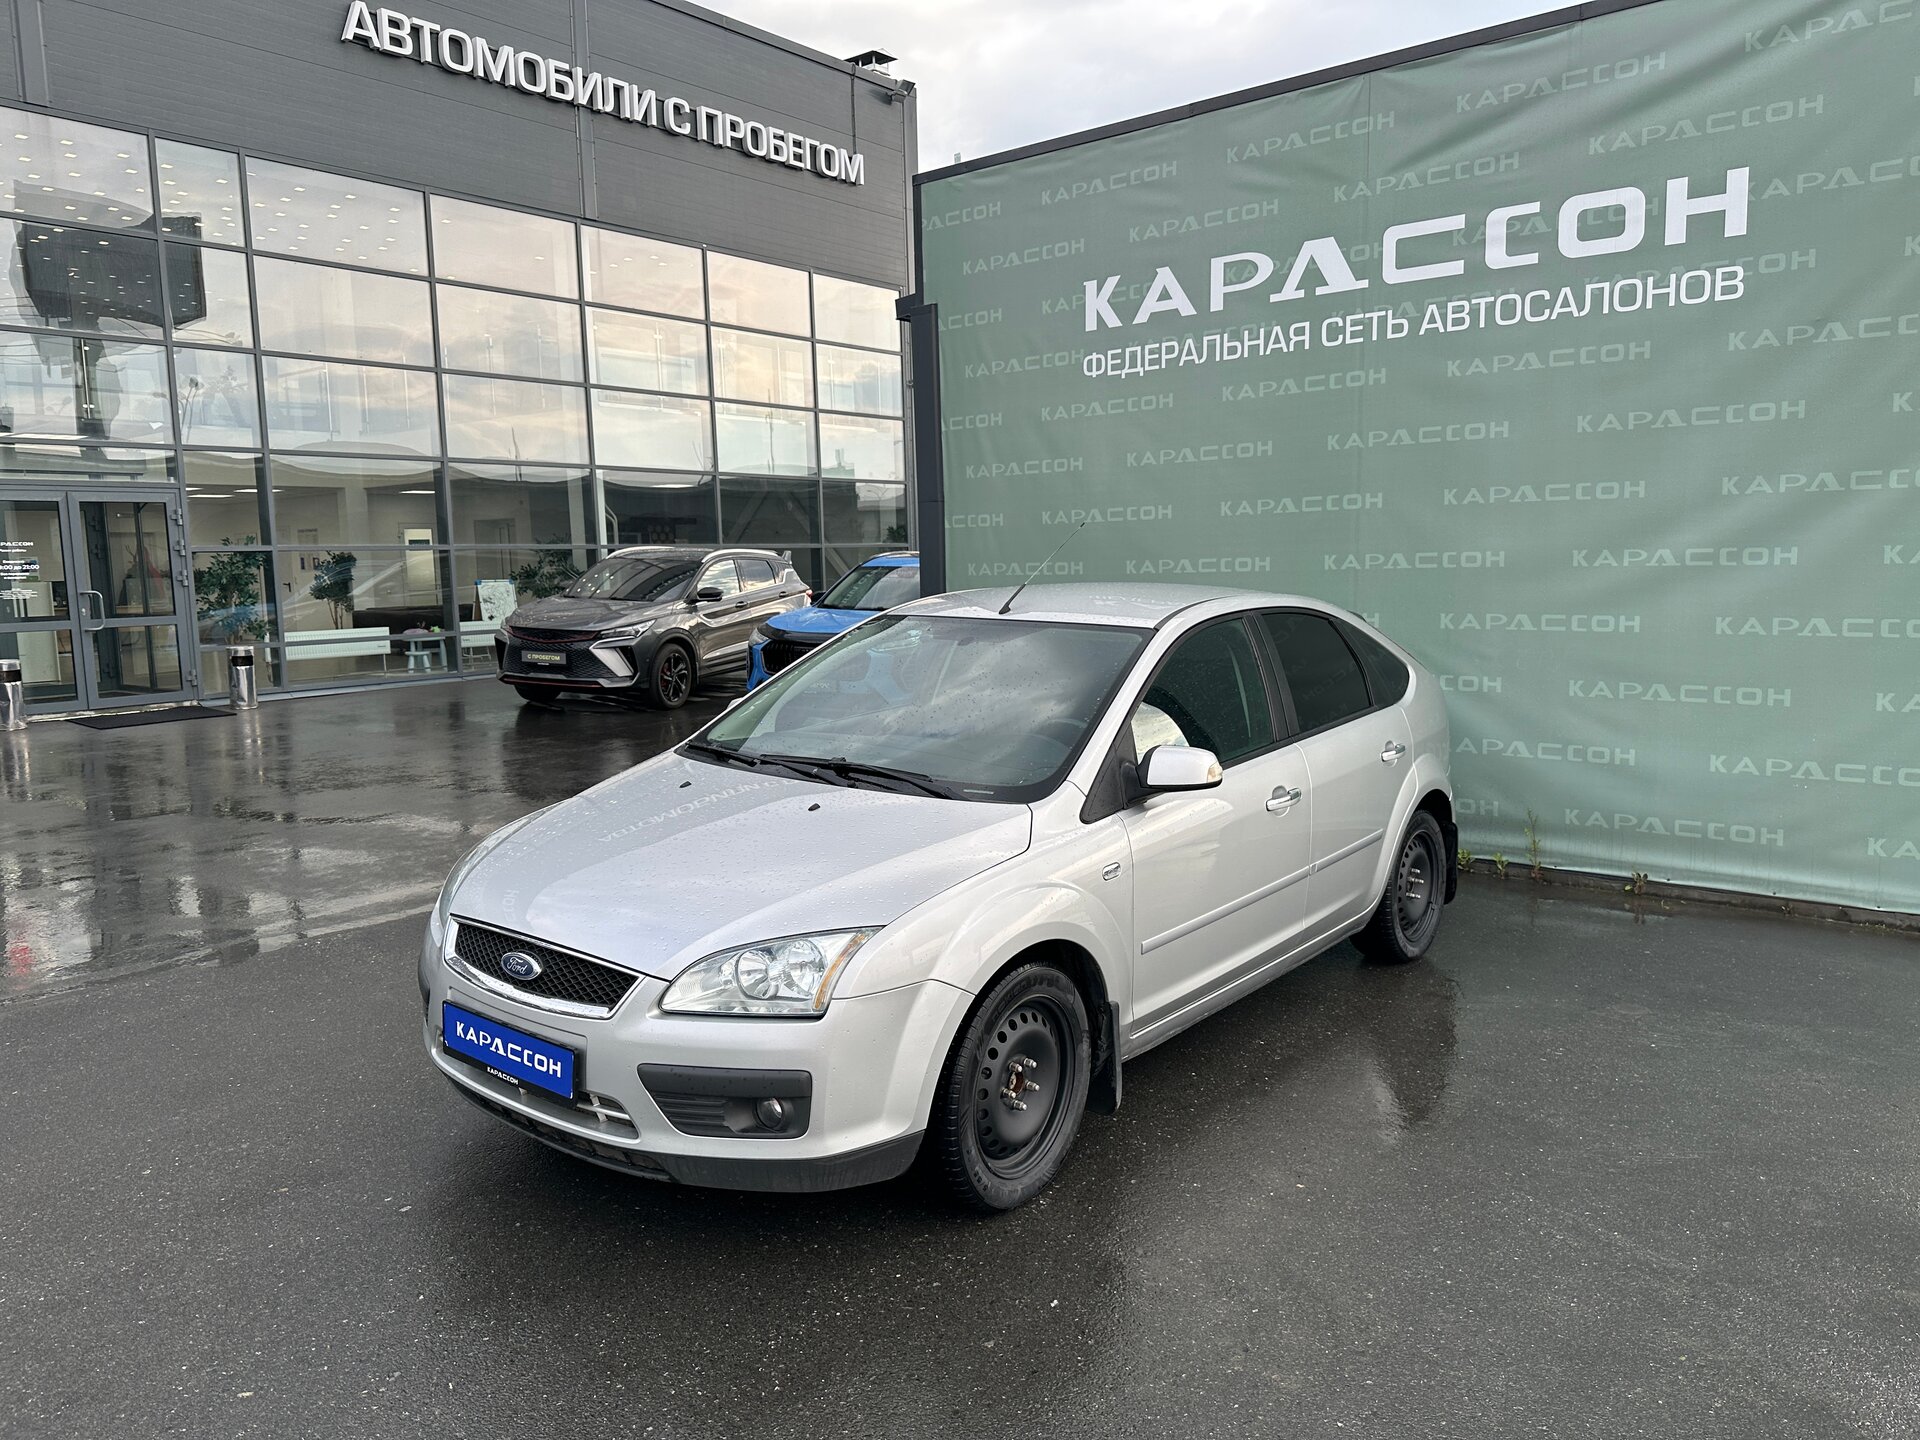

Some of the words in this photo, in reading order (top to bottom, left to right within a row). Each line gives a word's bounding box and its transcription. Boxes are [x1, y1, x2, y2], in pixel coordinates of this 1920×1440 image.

[342, 0, 657, 129] АВТОМОБИЛИ
[664, 97, 692, 136] С
[697, 107, 865, 186] ПРОБЕГОМ
[1456, 51, 1666, 113] КАРАССОН
[1227, 110, 1395, 164] КАРАССОН
[1589, 94, 1824, 155] КАРАССОН
[1041, 160, 1177, 205] КАРАССОН
[1334, 152, 1520, 203] КАРАССОН
[1129, 198, 1279, 244] КАРАССОН
[962, 237, 1085, 276] КАРАССОН
[1083, 166, 1749, 332] КАРАССОН
[1083, 321, 1310, 379] ФЕДЕРАЛЬНАЯ
[1321, 309, 1408, 350] СЕТЬ
[1418, 265, 1744, 335] АВТОСАЛОНОВ
[965, 349, 1085, 379] КАРАССОН
[1447, 340, 1651, 377] КАРАССОН
[1222, 367, 1387, 402] КАРАССОН
[1041, 393, 1174, 422] КАРАССОН
[1577, 399, 1806, 433] КАРАССОН
[1327, 421, 1509, 451] КАРАССОН
[966, 457, 1084, 479] КАРАССОН
[1126, 440, 1273, 468] КАРАССОН
[1220, 492, 1383, 517] КАРАССОН
[1444, 480, 1646, 505] КАРАССОН
[1041, 504, 1172, 525] КАРАССОН
[968, 561, 1084, 577] КАРАССОН
[1126, 556, 1271, 575] КАРАССОН
[1324, 551, 1505, 571] КАРАССОН
[1572, 546, 1798, 567] КАРАССОН
[1439, 613, 1641, 633] КАРАССОН
[1568, 679, 1791, 707] КАРАССОН
[1564, 808, 1784, 847] КАРАССОН
[507, 955, 528, 975] Ford
[455, 1020, 562, 1079] КАРАССОН
